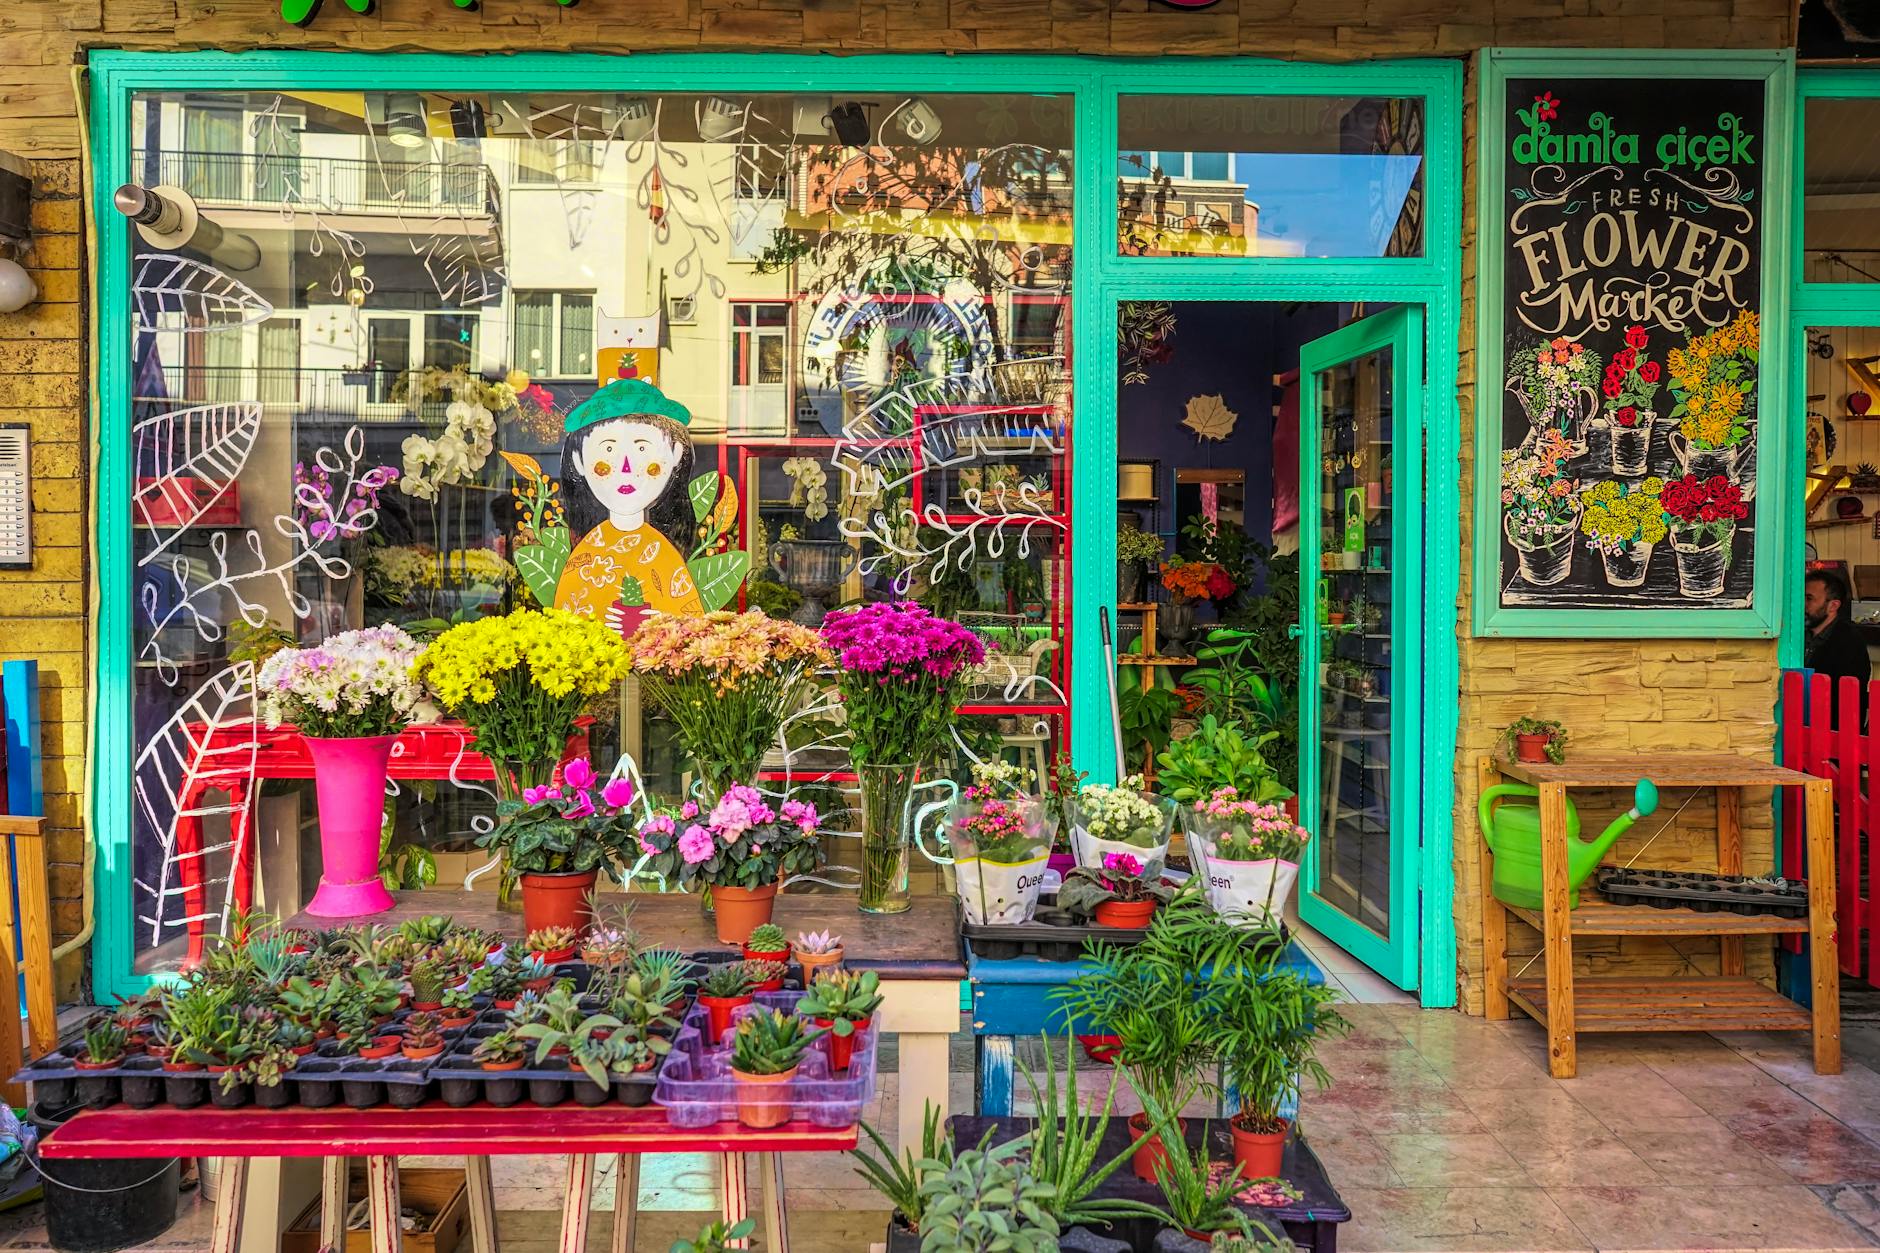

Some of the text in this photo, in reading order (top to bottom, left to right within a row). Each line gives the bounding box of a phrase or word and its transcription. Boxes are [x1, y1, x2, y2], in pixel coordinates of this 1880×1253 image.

[1512, 102, 1755, 171] damla çiçek
[1592, 188, 1679, 213] FRESH
[1513, 210, 1750, 307] FLOWER
[1516, 272, 1732, 342] Market
[1210, 876, 1231, 889] een
